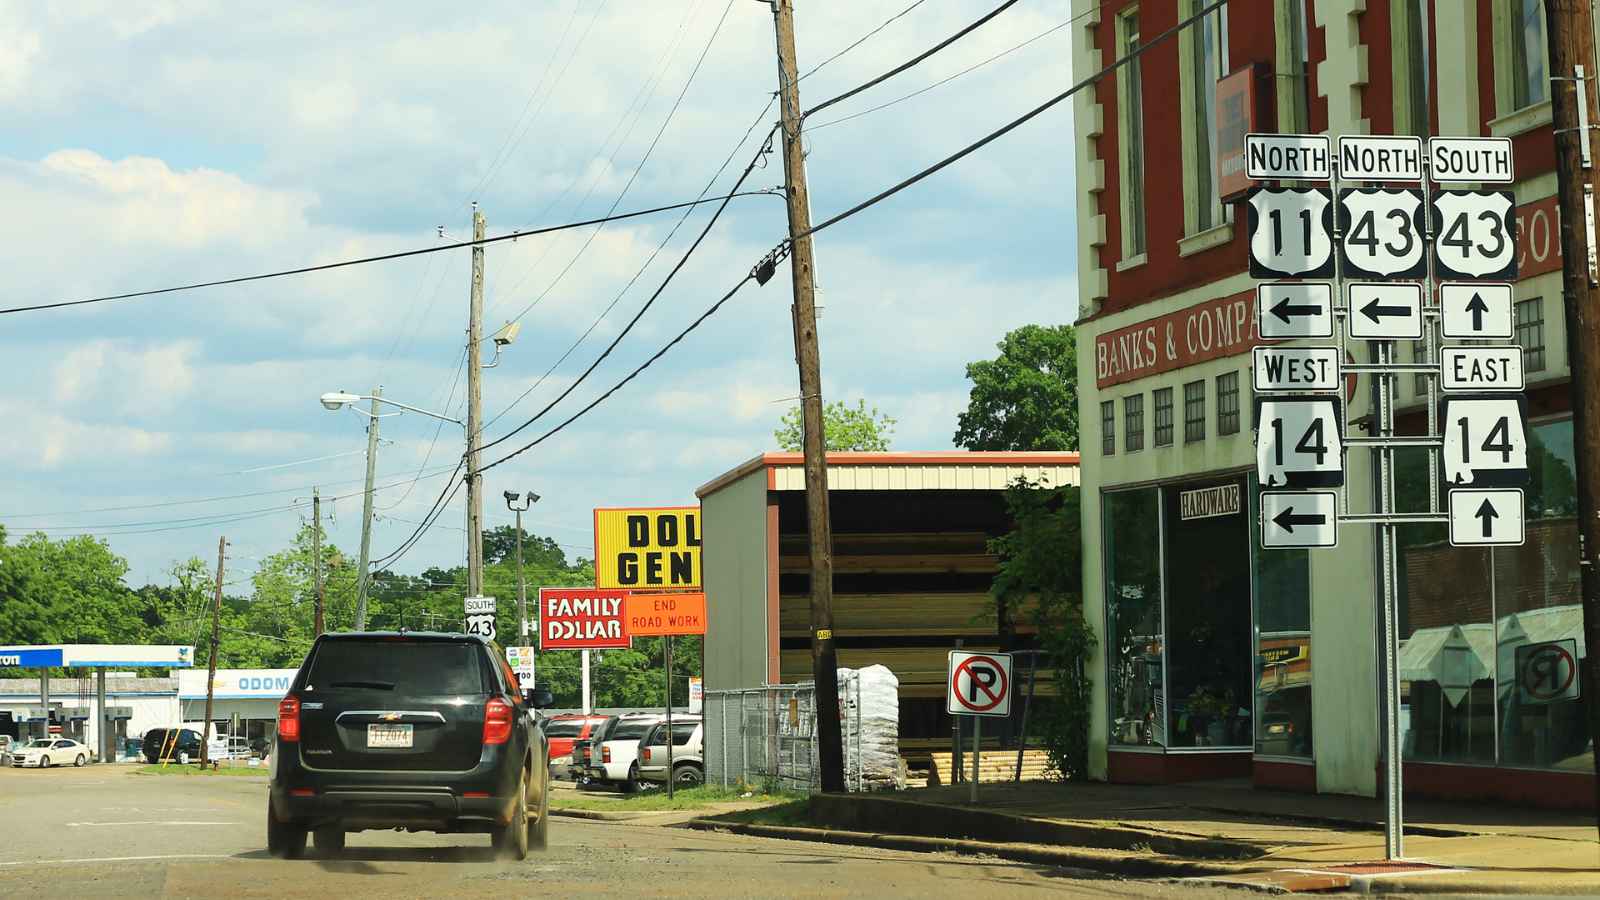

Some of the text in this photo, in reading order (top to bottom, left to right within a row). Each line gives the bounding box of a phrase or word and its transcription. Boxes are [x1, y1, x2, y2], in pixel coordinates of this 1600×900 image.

[1250, 143, 1326, 172] NORTH
[1344, 144, 1418, 173] NORTH
[1435, 146, 1509, 175] SOUTH
[1269, 209, 1311, 256] 11
[1348, 208, 1414, 258] 43
[1442, 210, 1505, 258] 43
[1097, 326, 1157, 379] BANKS
[1166, 321, 1178, 361] &
[1264, 355, 1329, 383] WEST
[1454, 354, 1510, 382] EAST
[1271, 417, 1328, 466] 14
[1457, 416, 1514, 464] 14
[1182, 486, 1239, 517] HARDWARE
[627, 514, 701, 547] DOL
[618, 552, 692, 585] GEN
[467, 600, 494, 610] SOUTH
[547, 597, 622, 617] FAMILY
[654, 600, 677, 611] END
[469, 620, 493, 637] 43
[548, 620, 622, 640] DOLLAR
[632, 615, 700, 628] ROAD WORK
[239, 678, 289, 690] ODOM
